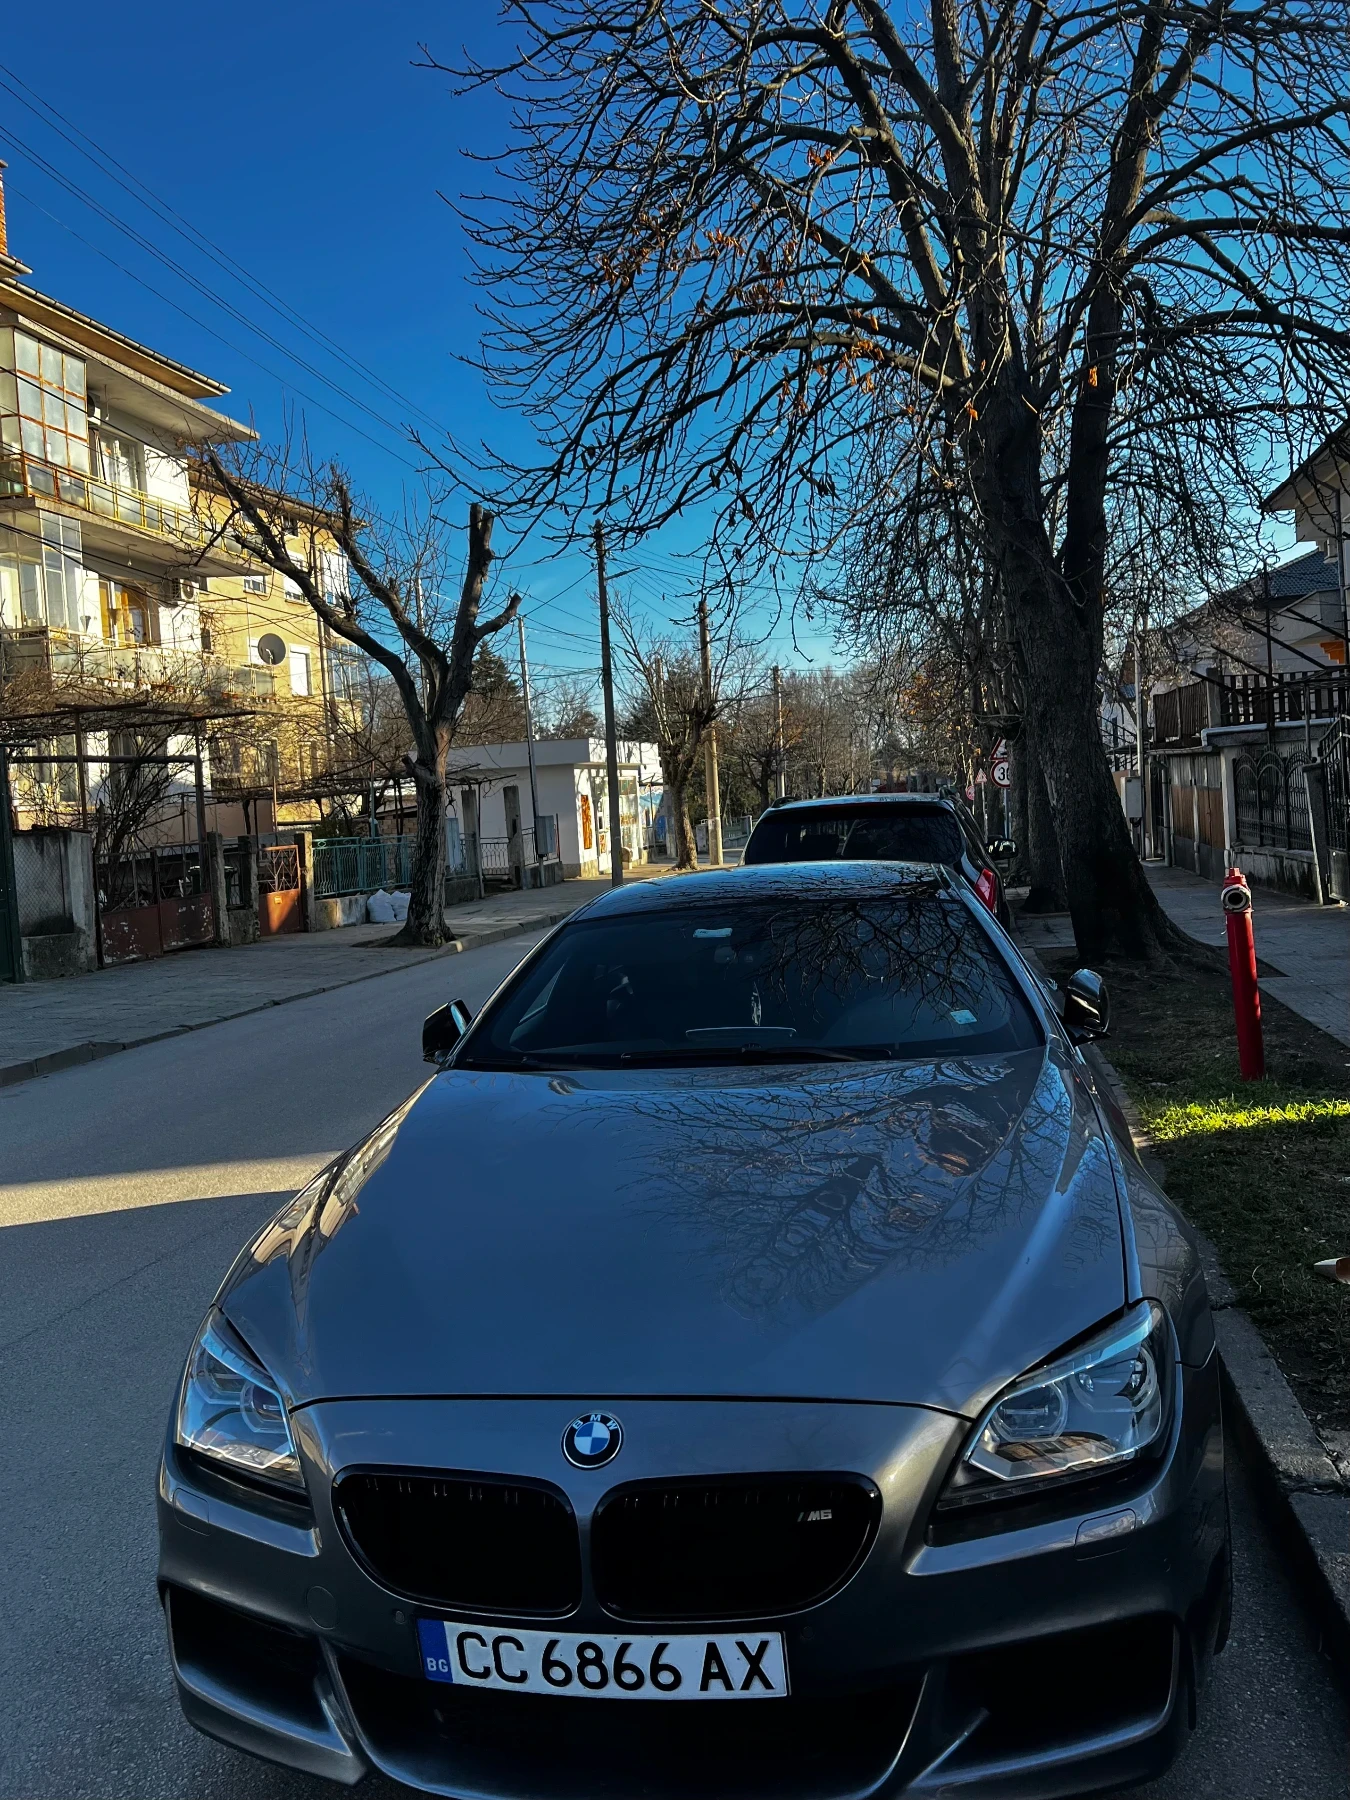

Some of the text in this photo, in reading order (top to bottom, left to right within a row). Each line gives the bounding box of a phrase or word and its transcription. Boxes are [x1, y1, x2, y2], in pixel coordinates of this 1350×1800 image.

[572, 1413, 617, 1430] BMW
[427, 1657, 449, 1673] BG
[456, 1631, 775, 1692] CC 6866 AX
